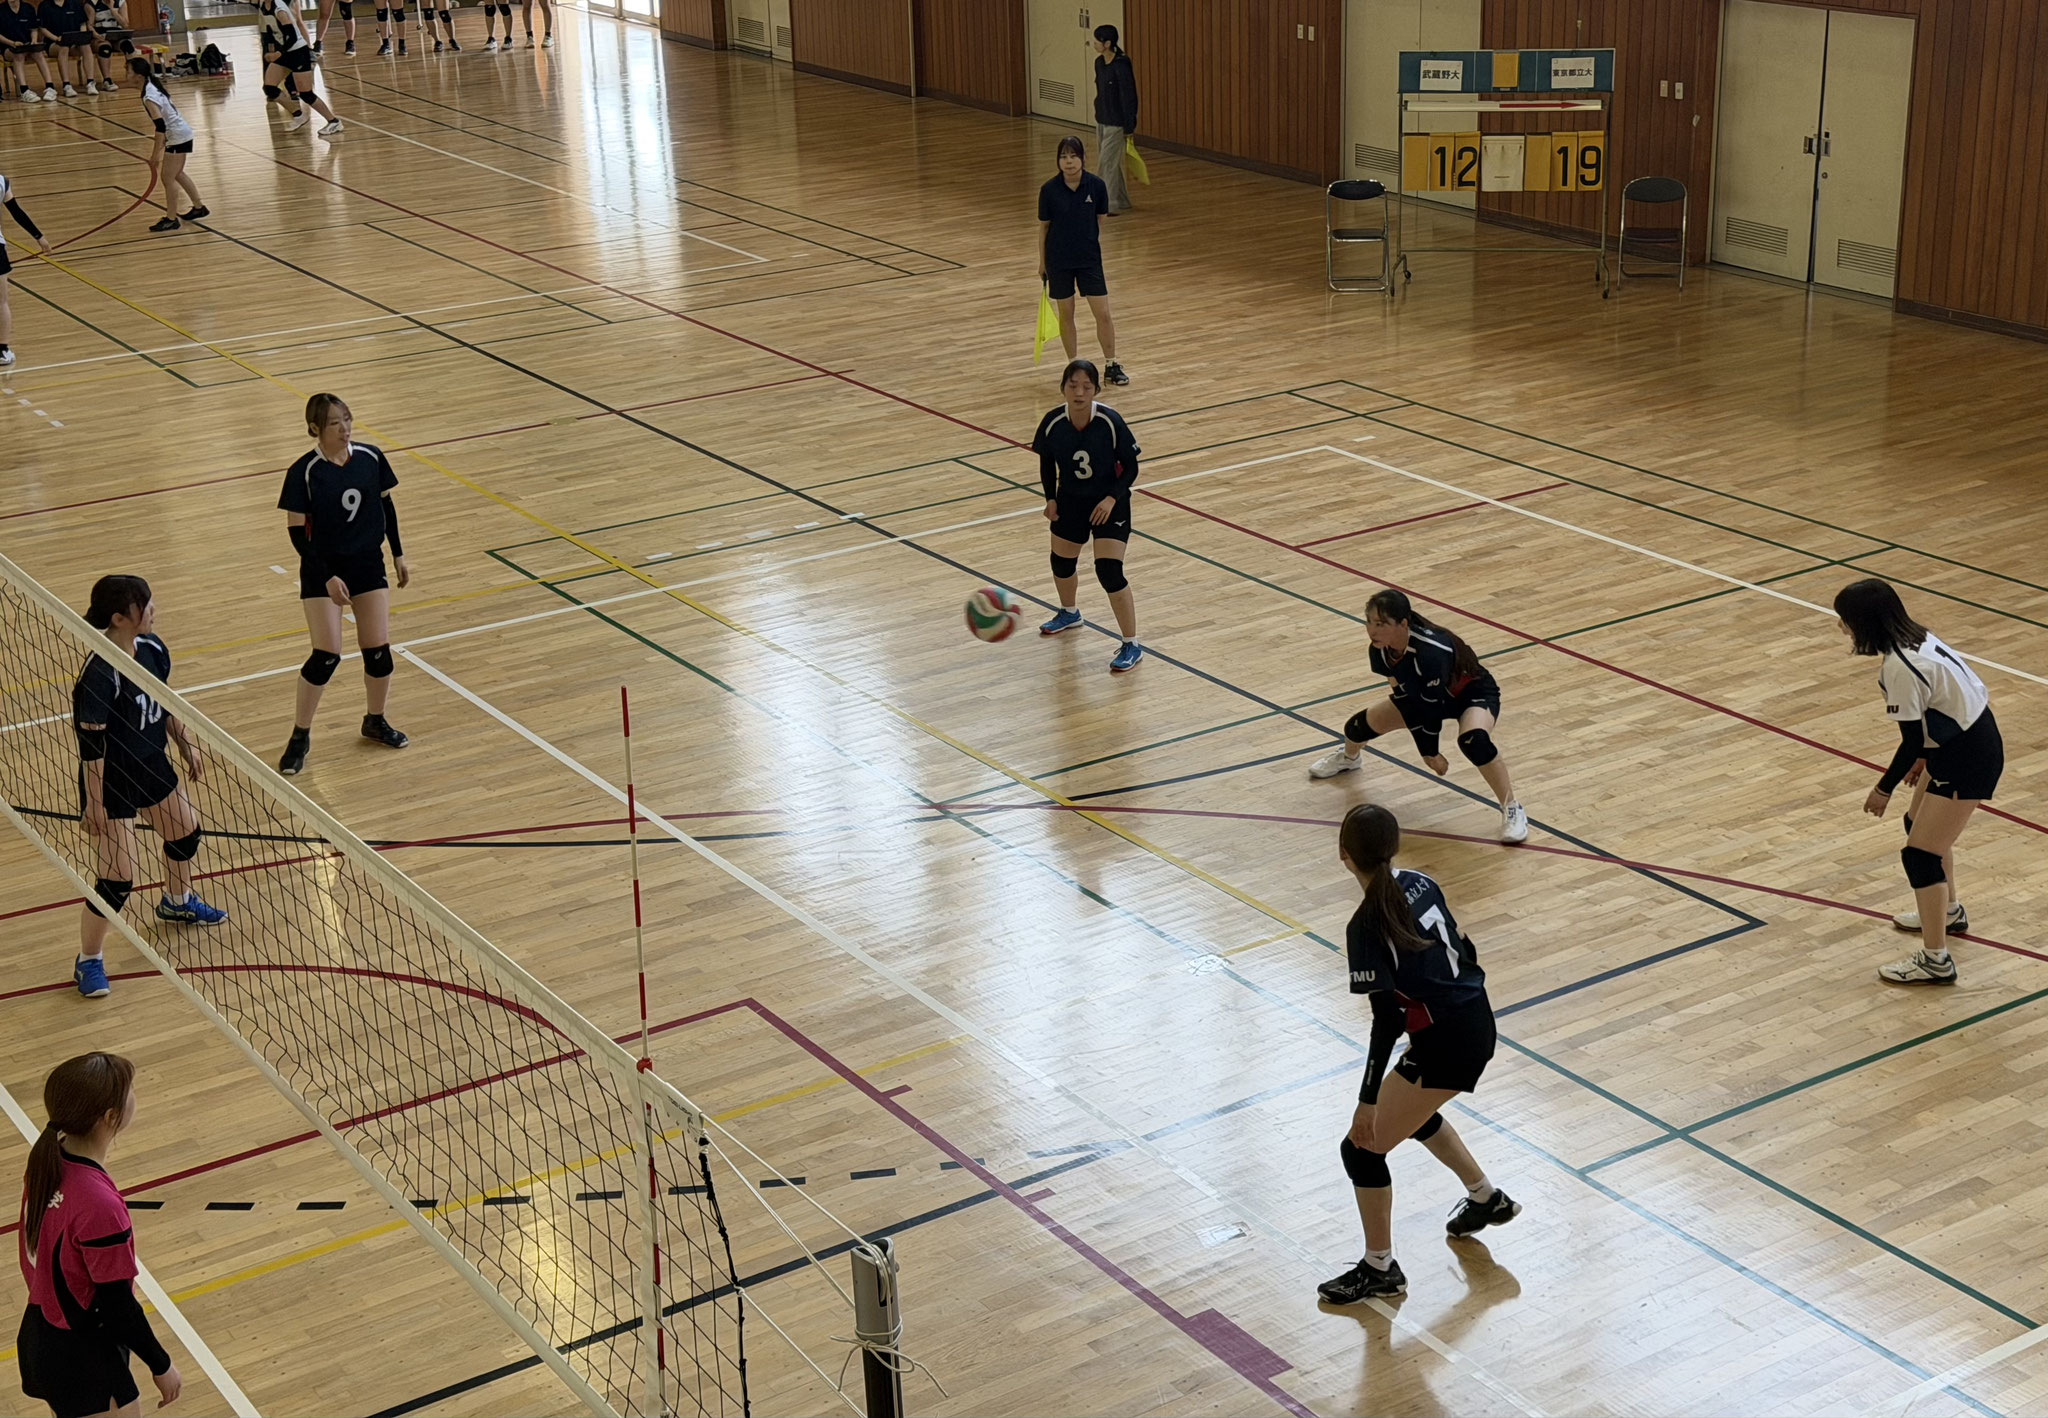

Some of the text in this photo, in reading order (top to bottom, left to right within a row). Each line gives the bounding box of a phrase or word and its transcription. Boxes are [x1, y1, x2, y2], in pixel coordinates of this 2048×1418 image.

[1422, 69, 1460, 80] 武蔵野大
[1552, 68, 1592, 77] 東京都立大
[1433, 146, 1478, 187] 12
[1556, 145, 1602, 187] 19
[1072, 450, 1093, 480] 3
[341, 488, 362, 522] 9
[135, 693, 162, 730] 10
[1418, 903, 1460, 979] 7
